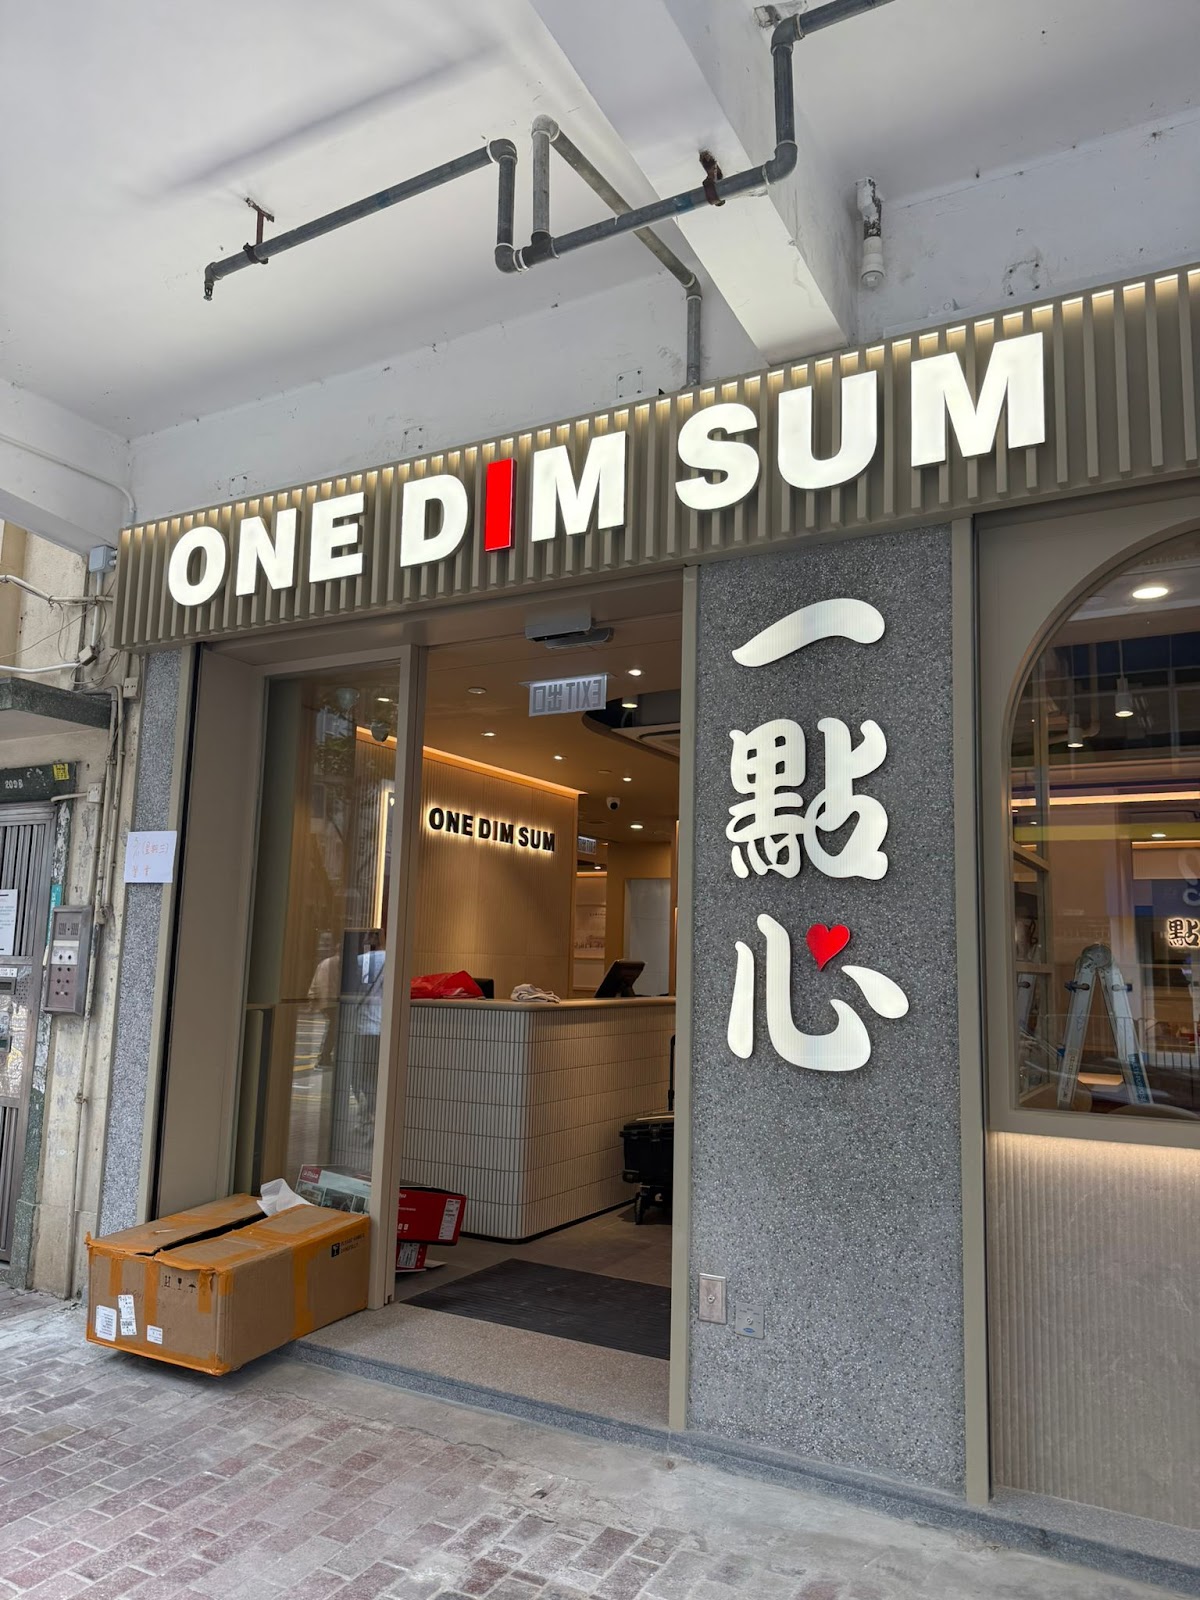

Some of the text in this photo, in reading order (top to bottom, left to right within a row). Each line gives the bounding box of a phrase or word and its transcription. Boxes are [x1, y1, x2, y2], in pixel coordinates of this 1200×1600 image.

[167, 332, 1045, 607] ONE DIM SUM
[429, 807, 473, 837] ONE
[478, 817, 515, 844] DIM
[518, 826, 555, 852] SUM
[725, 597, 910, 1072] 一點心
[1168, 919, 1199, 946] 點
